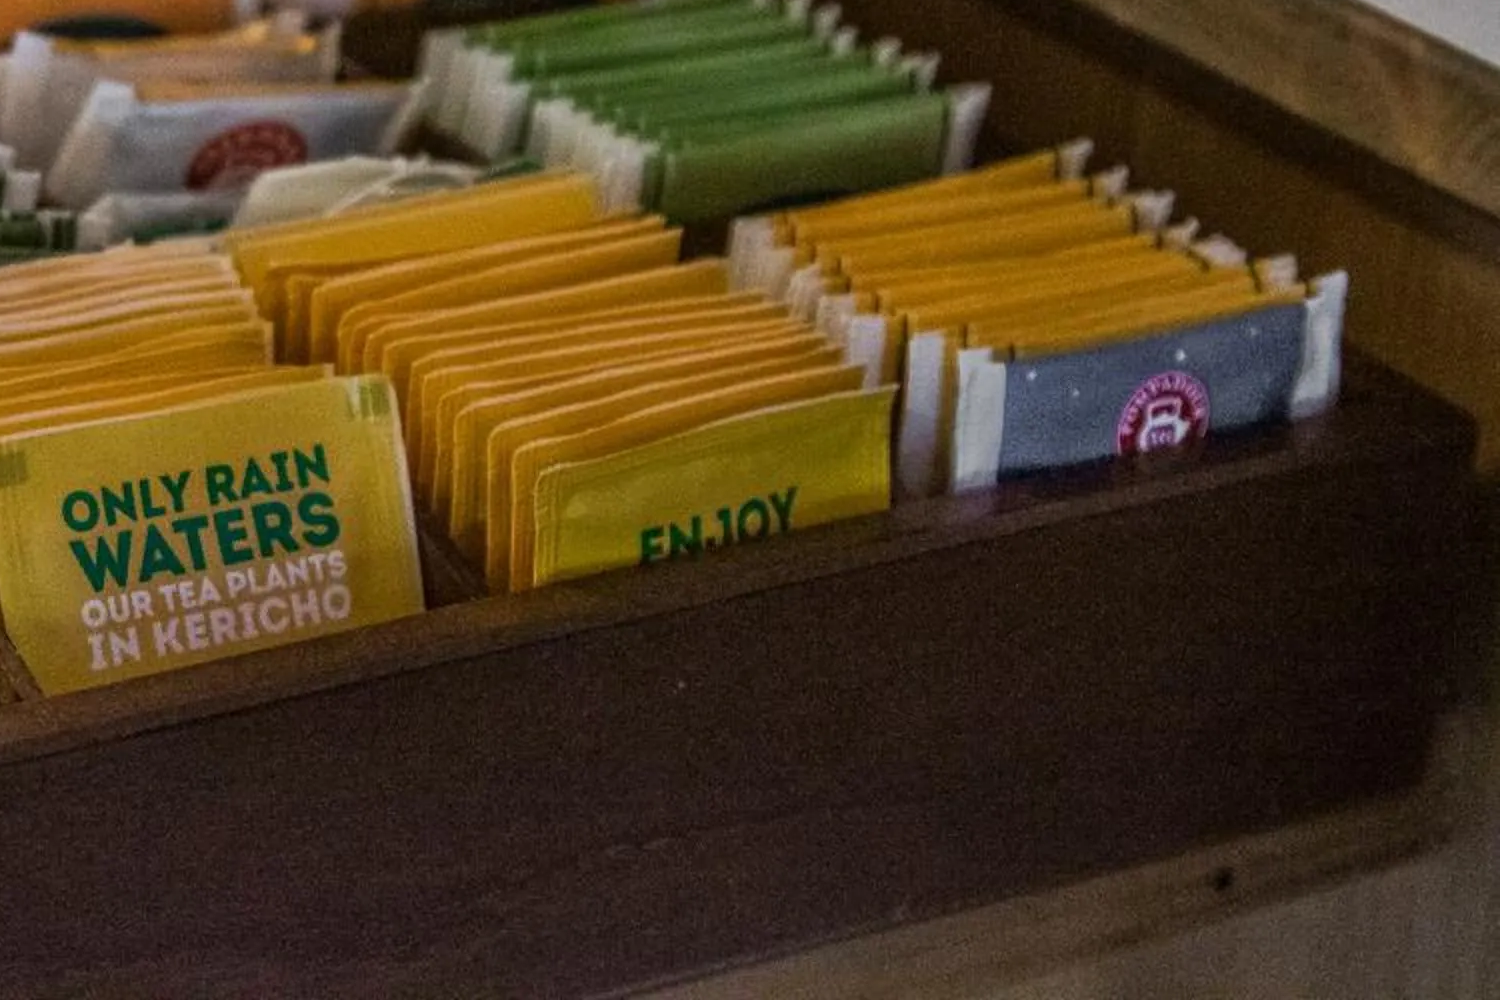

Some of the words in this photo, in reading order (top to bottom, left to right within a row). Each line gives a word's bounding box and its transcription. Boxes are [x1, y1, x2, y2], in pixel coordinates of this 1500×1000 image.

[61, 470, 190, 532] ONLY
[205, 443, 330, 506] RAIN
[639, 486, 797, 563] ENJOY
[69, 493, 341, 592] WATERS
[81, 589, 155, 628] OUR
[158, 577, 222, 613] TEA
[226, 550, 348, 597] PLANTS
[88, 627, 141, 670] IN
[153, 584, 352, 657] KERICHO
